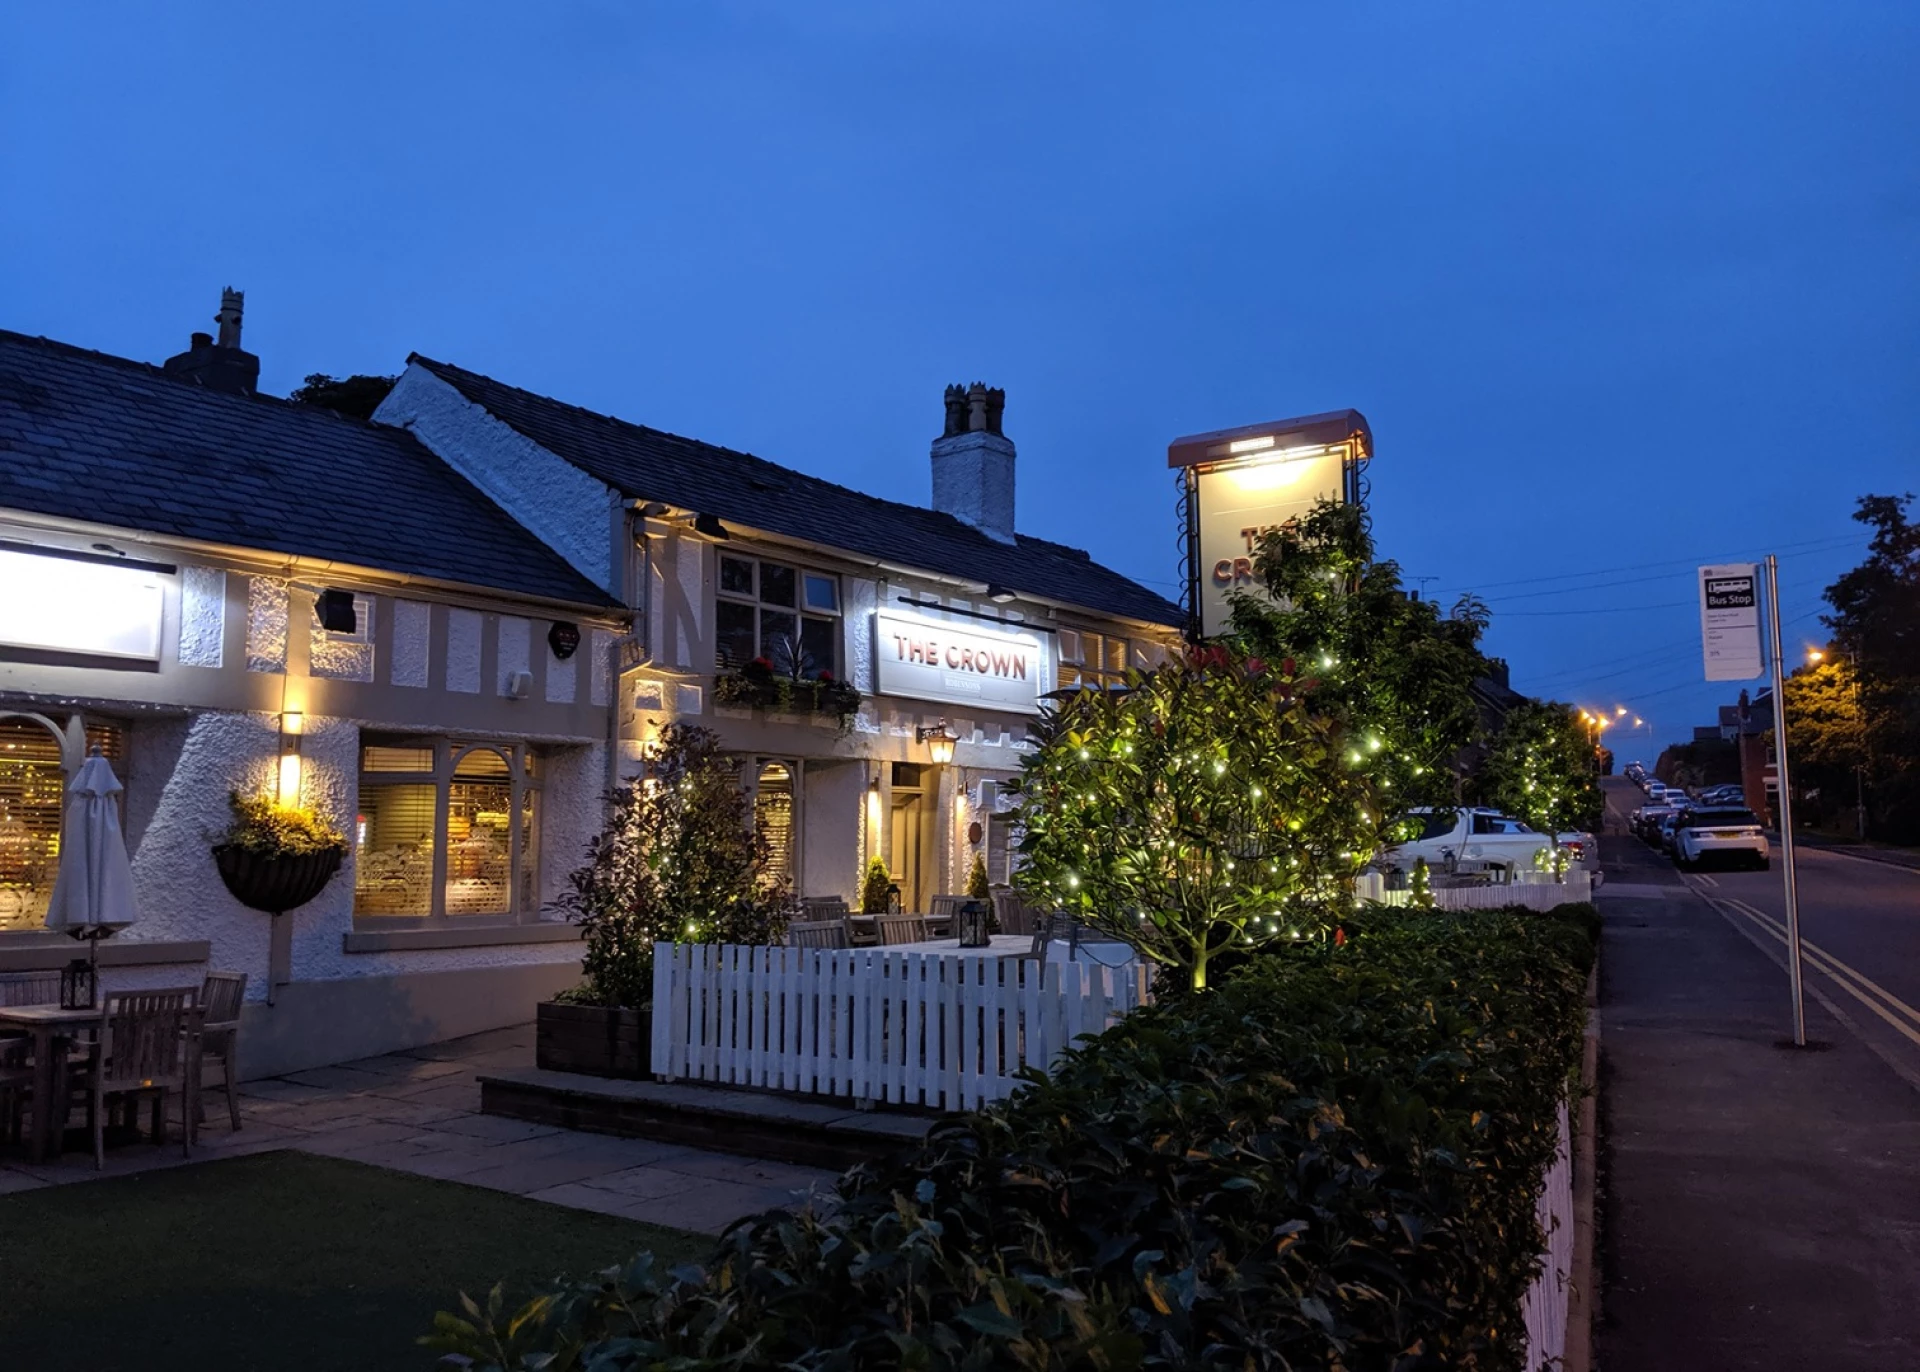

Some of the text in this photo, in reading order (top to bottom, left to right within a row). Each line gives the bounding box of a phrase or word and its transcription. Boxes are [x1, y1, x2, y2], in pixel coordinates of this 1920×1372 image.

[1709, 595, 1752, 606] Bus Stop
[893, 633, 1027, 681] THE CROWN
